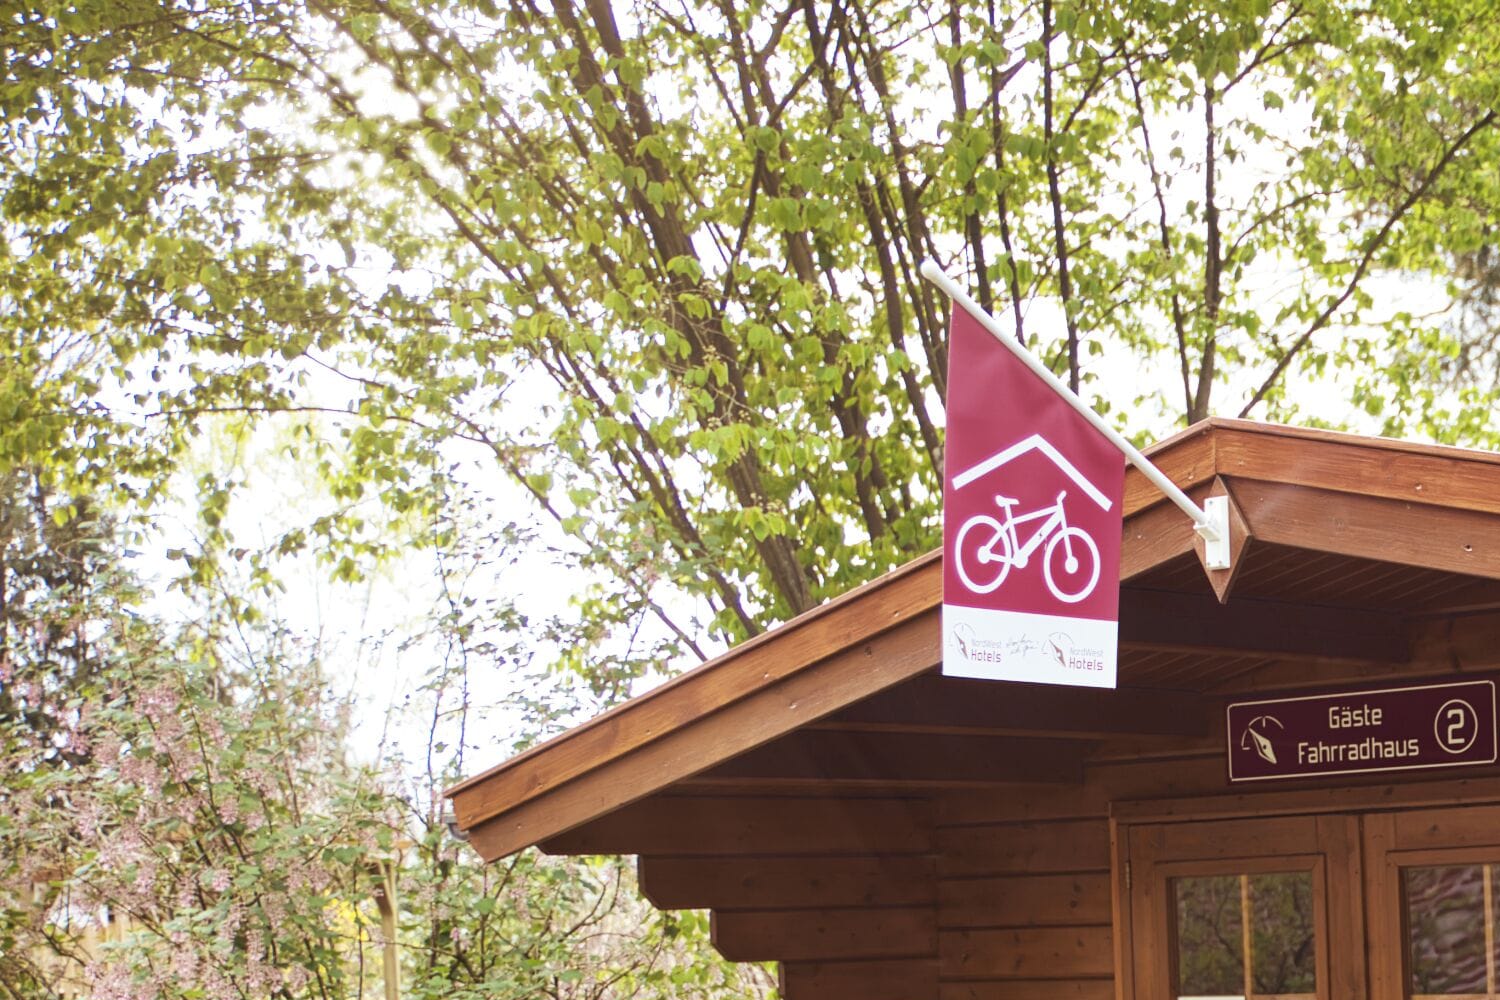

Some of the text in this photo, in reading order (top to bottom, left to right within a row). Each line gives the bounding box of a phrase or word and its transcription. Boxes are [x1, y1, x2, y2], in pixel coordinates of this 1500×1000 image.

[971, 649, 1001, 663] Hotels
[1069, 658, 1103, 671] Hotels
[1328, 704, 1382, 729] Gäste
[1447, 708, 1466, 744] 2
[1298, 737, 1419, 765] Fahrradhaus
